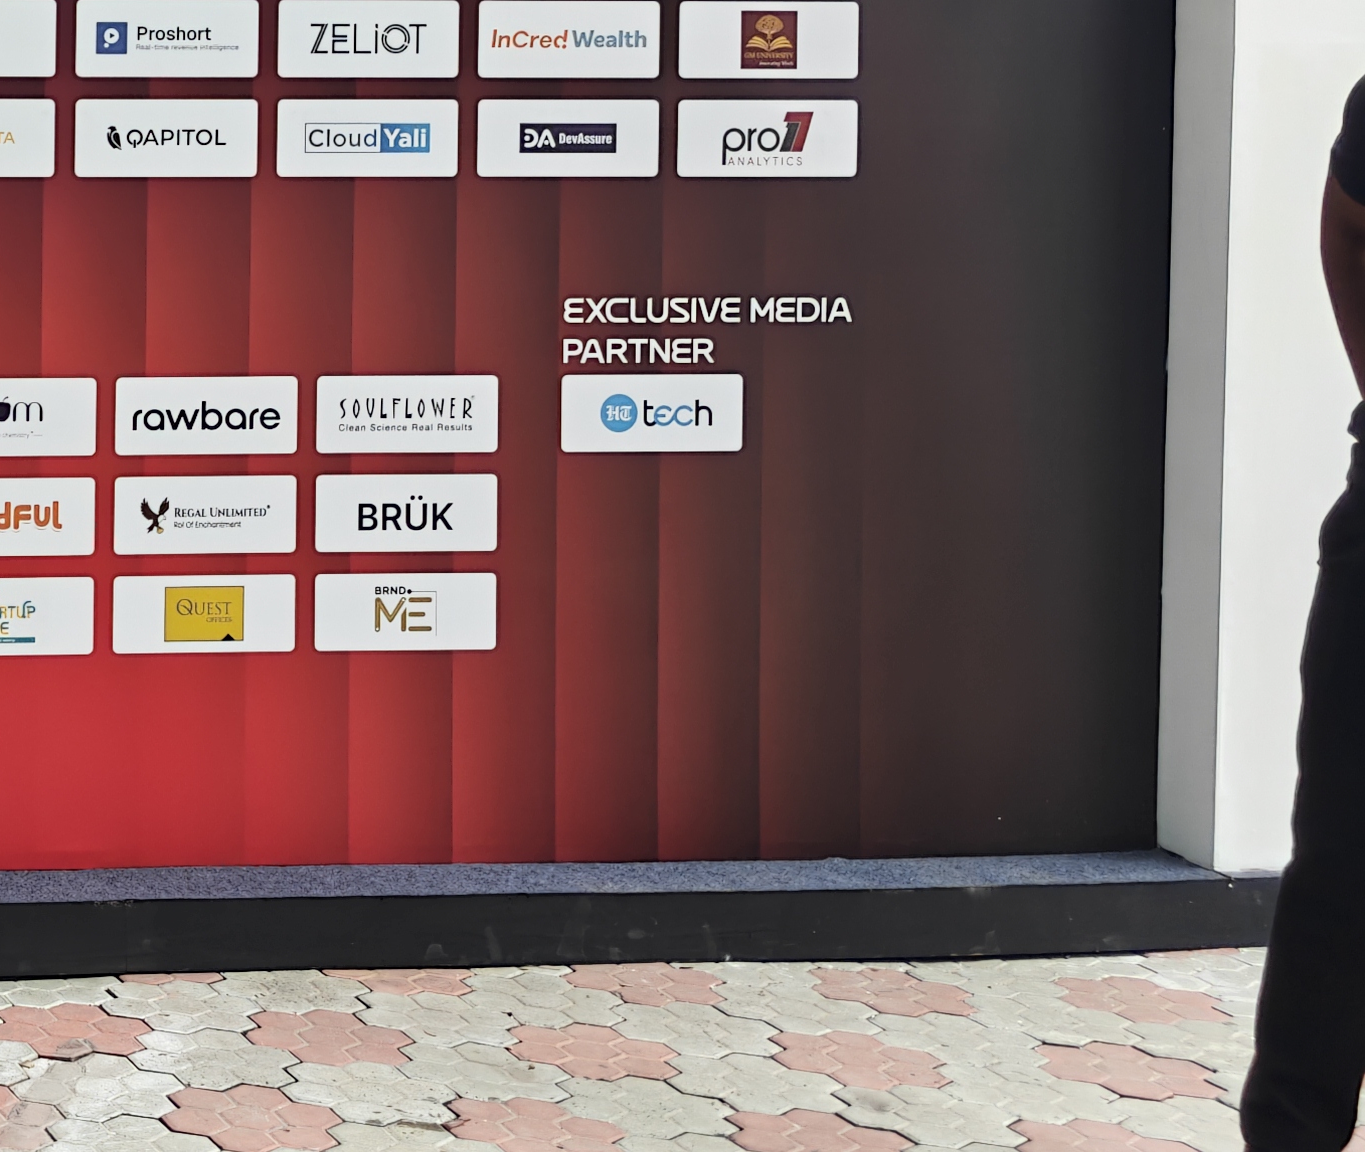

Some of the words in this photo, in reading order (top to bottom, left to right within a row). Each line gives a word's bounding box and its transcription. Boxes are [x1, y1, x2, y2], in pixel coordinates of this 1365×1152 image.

[136, 26, 212, 42] Proshort
[571, 30, 647, 48] Wealth
[126, 129, 227, 148] QAPITOL
[559, 132, 613, 145] DevAssure
[728, 156, 803, 166] ANALYTICS
[563, 297, 741, 324] EXCLUSIVE
[749, 296, 853, 324] MEDIA
[562, 338, 715, 364] PARTNER
[133, 400, 281, 431] rawbare
[339, 398, 473, 420] SOULFLOWER
[339, 423, 366, 432] Clean
[369, 423, 407, 432] Science
[411, 423, 433, 432] Real
[436, 422, 473, 432] Results
[357, 495, 454, 531] BRÜK
[375, 586, 407, 594] BRND
[375, 596, 433, 632] ME
